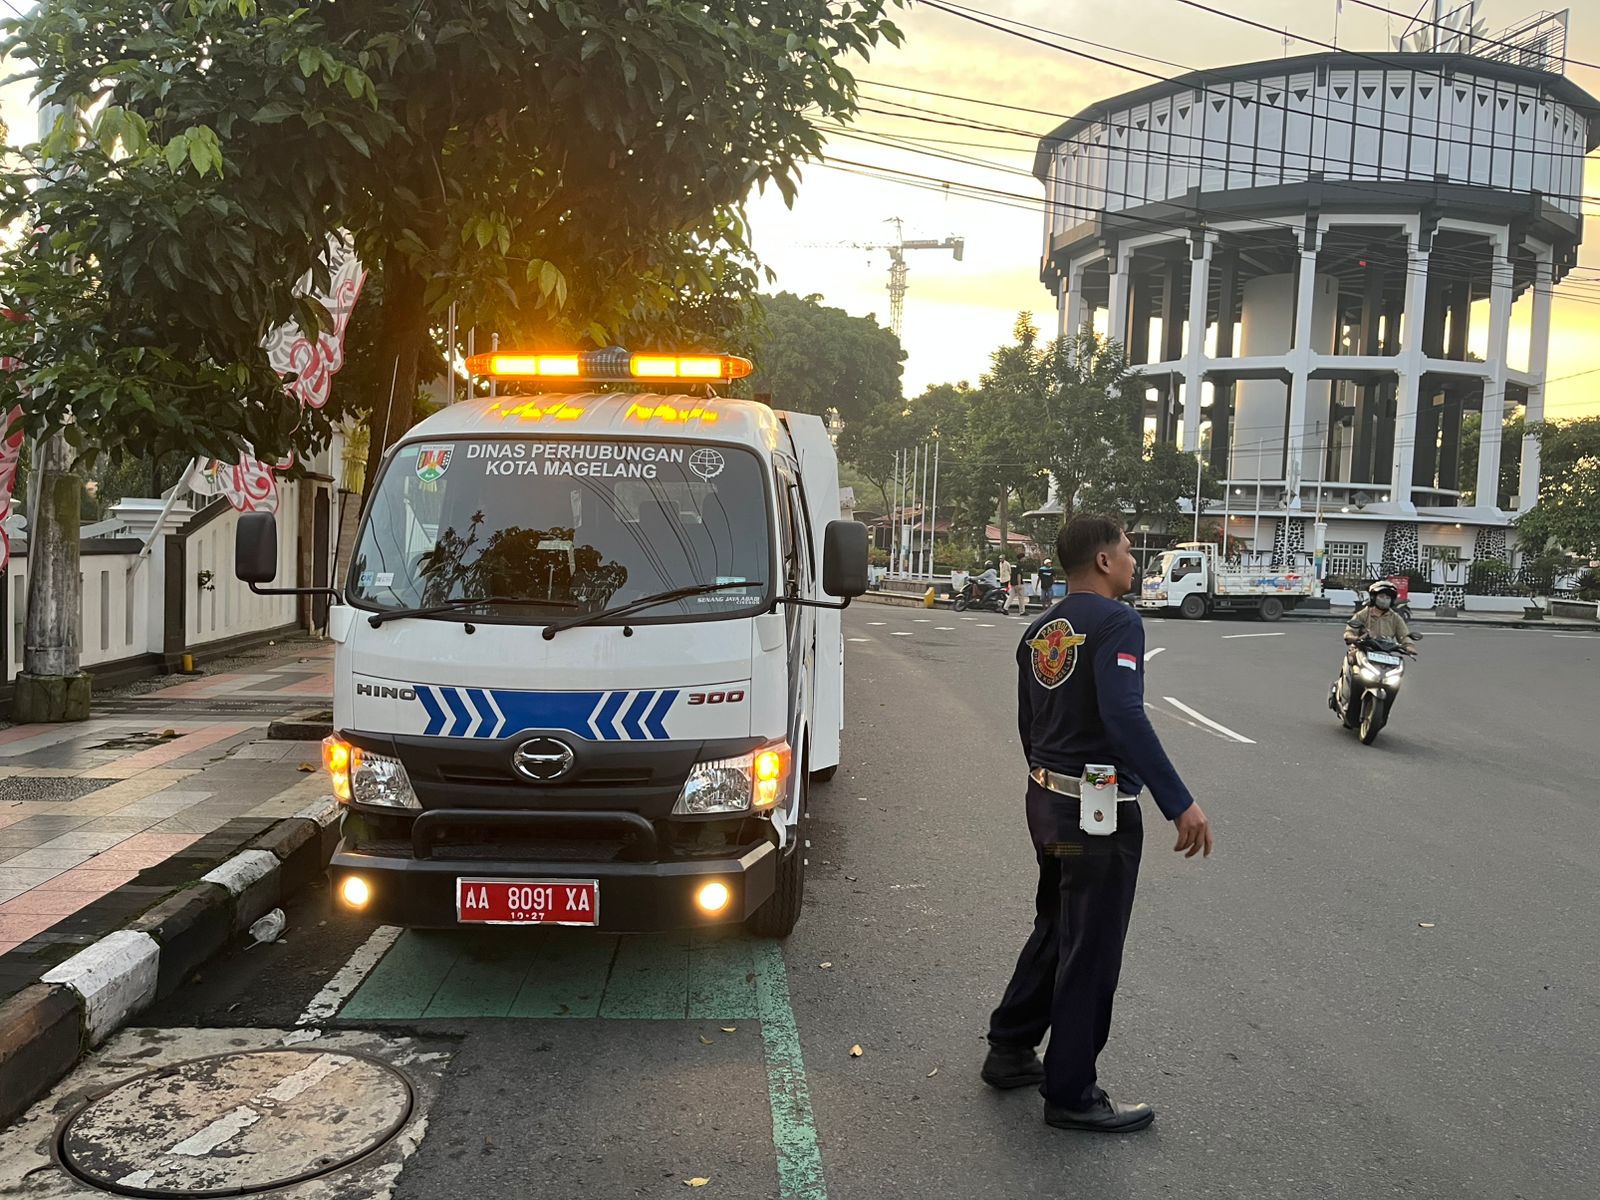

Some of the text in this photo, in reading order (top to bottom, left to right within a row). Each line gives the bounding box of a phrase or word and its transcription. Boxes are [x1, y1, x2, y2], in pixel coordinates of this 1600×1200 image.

[467, 444, 526, 459] DINAS
[532, 444, 684, 463] PERHUBUNGAN
[485, 461, 657, 479] KOTA MAGELANG
[1041, 621, 1070, 638] PATROLI
[357, 683, 417, 701] HINO
[687, 690, 745, 705] 300
[465, 886, 590, 911] AA 8091 XA
